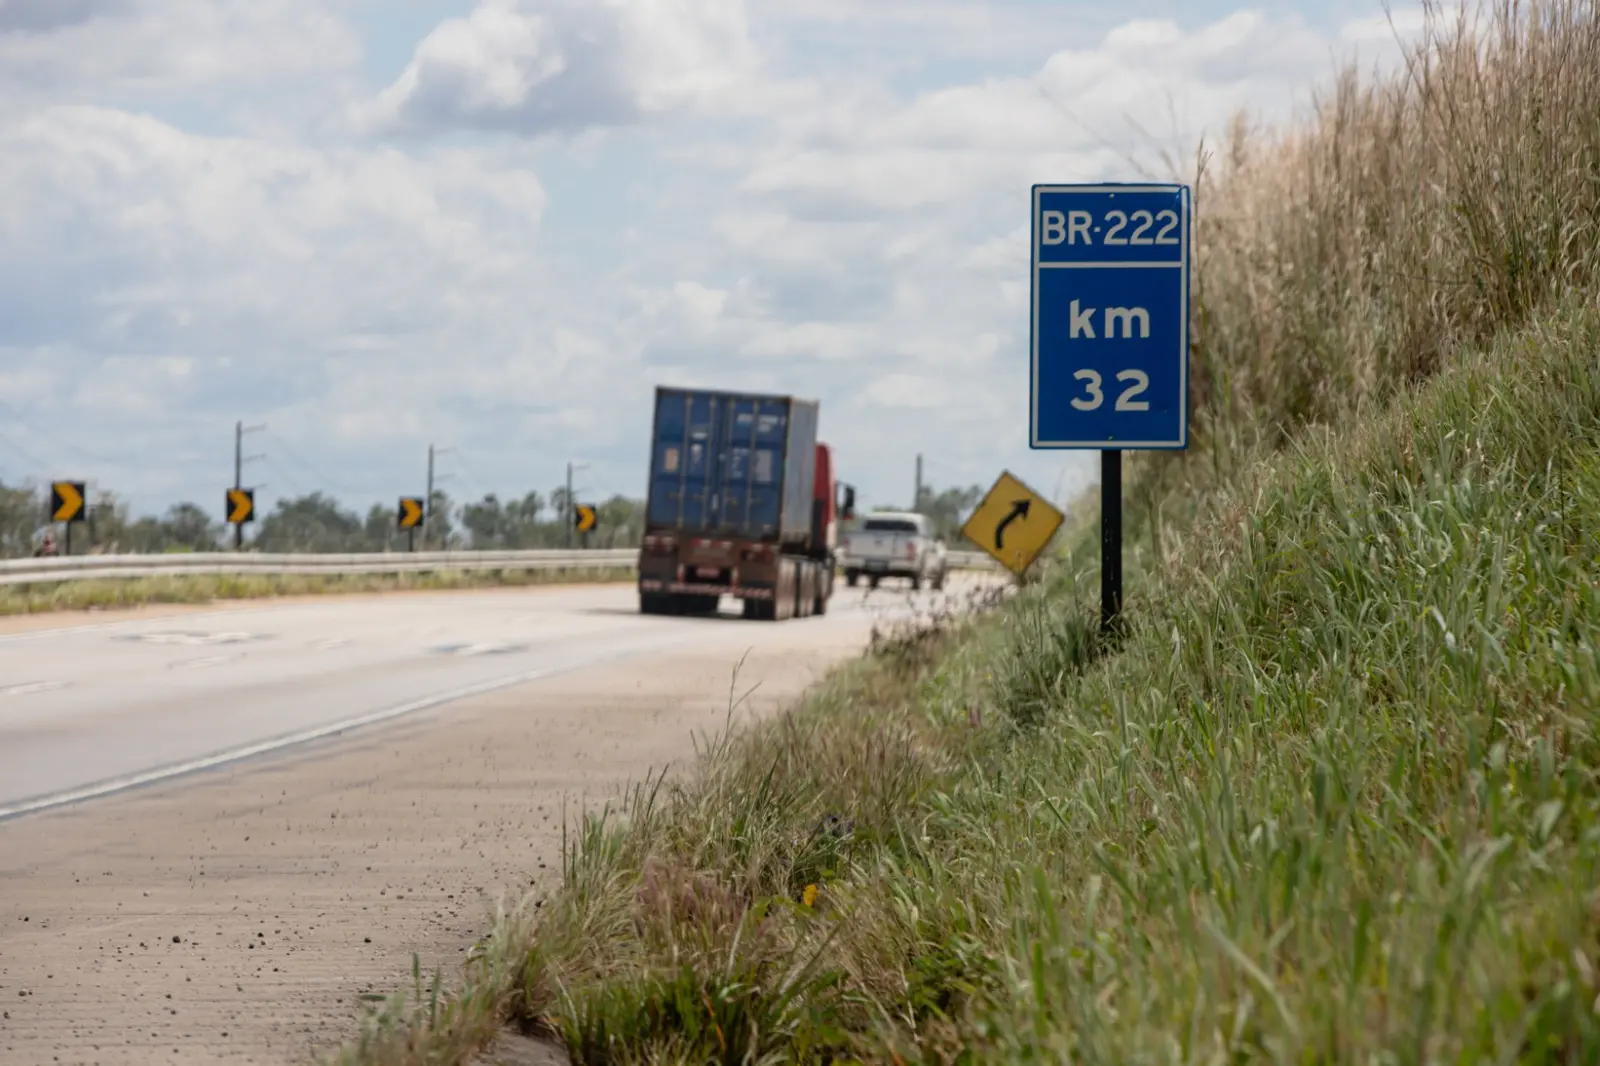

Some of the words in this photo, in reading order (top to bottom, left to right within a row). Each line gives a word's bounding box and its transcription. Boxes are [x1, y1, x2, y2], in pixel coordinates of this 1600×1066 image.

[1042, 210, 1179, 245] BR-222
[1069, 298, 1150, 338] km
[1070, 368, 1149, 412] 32
